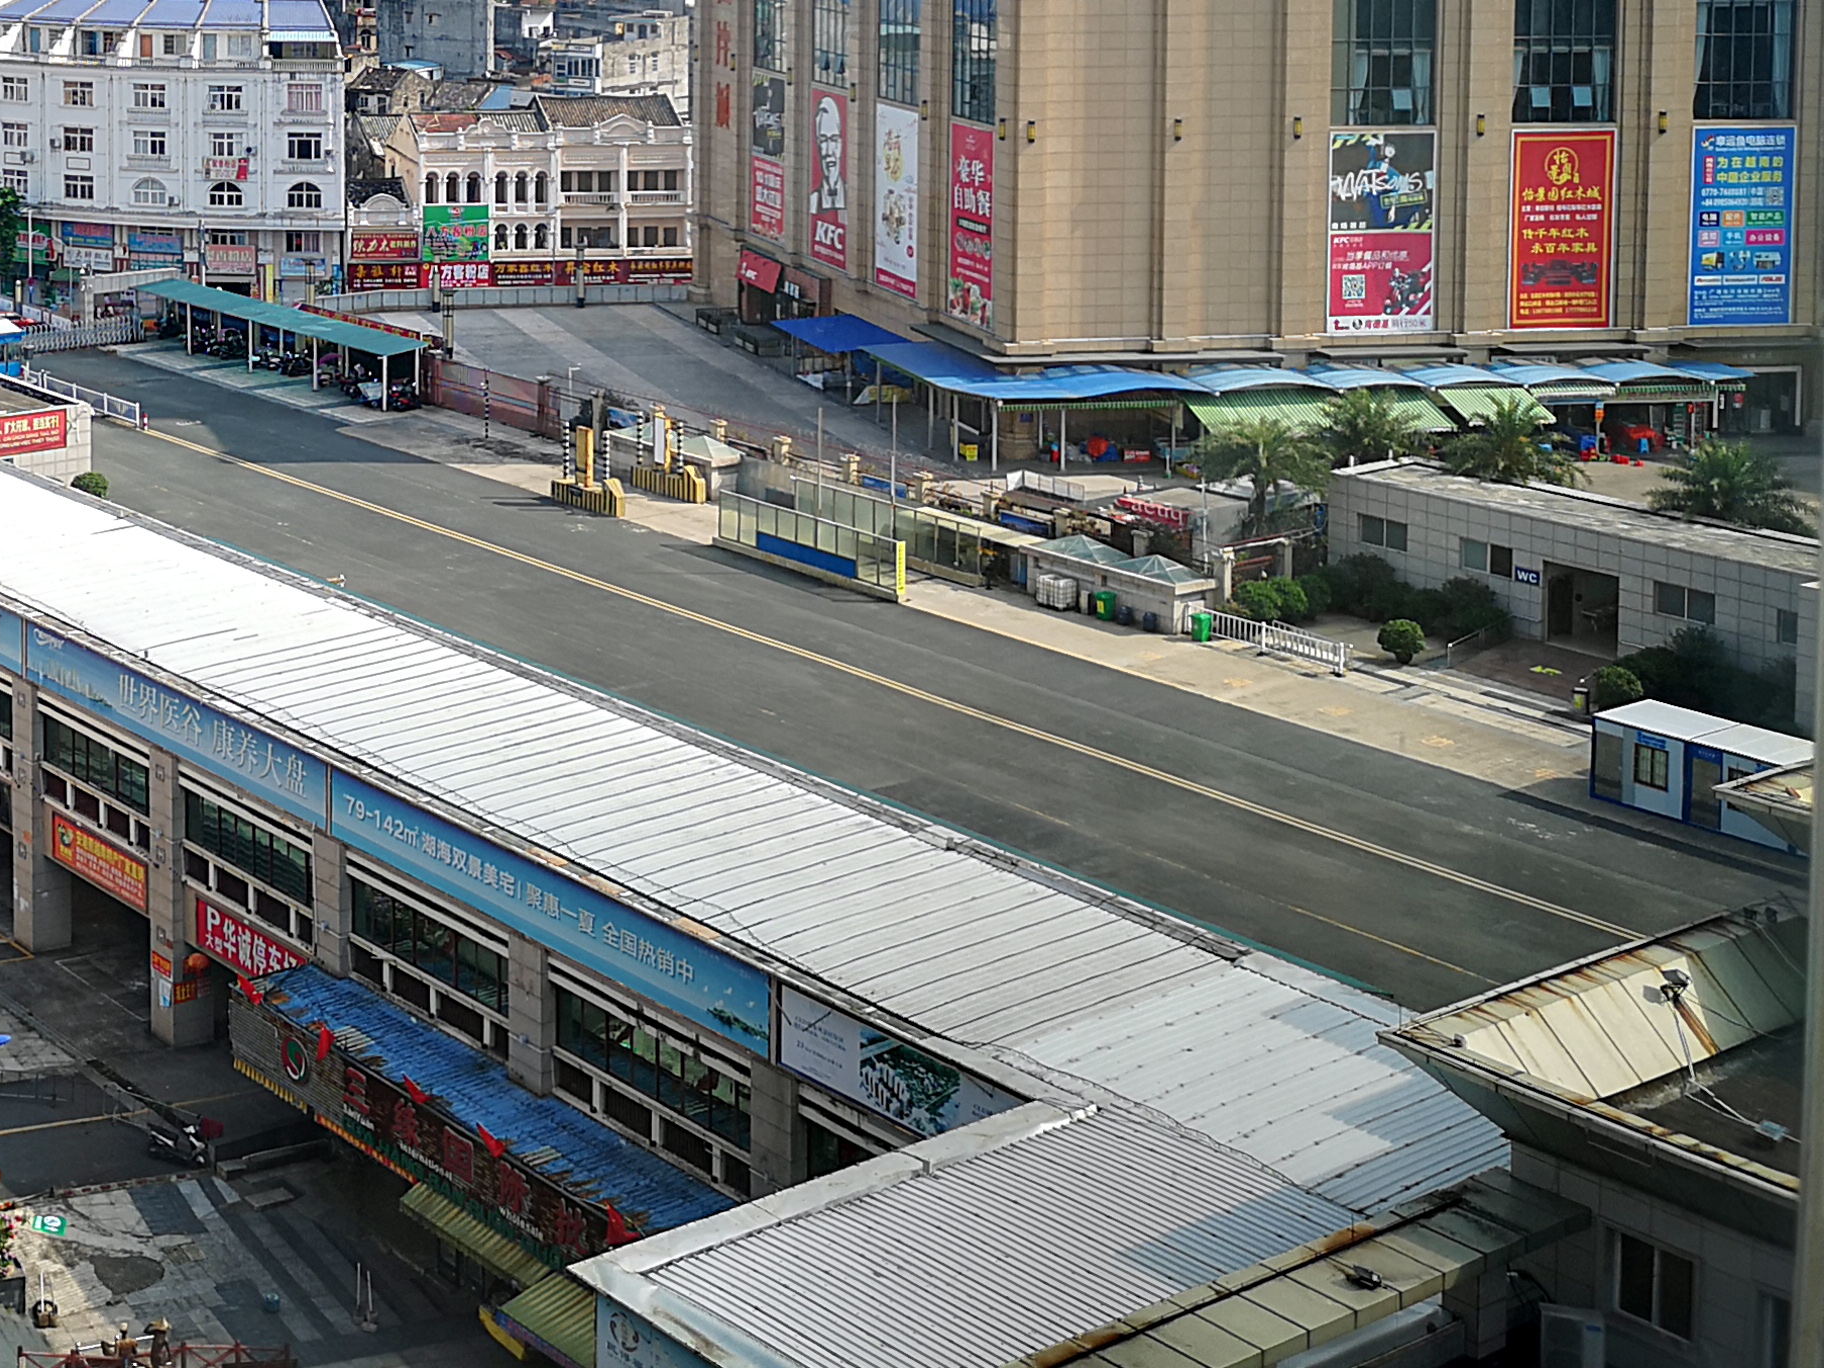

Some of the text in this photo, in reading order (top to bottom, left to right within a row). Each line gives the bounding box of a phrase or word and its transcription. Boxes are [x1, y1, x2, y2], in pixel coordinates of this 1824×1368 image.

[954, 183, 991, 218] 自助餐
[814, 220, 845, 251] KFC
[1517, 570, 1538, 583] WC
[118, 673, 308, 801] 世界医谷 康养大盘
[207, 905, 221, 932] P
[420, 829, 516, 897] 湖海双景美宅
[525, 888, 596, 936] 聚惠一夏
[601, 919, 697, 985] 全国热销中
[205, 934, 223, 953] 大型
